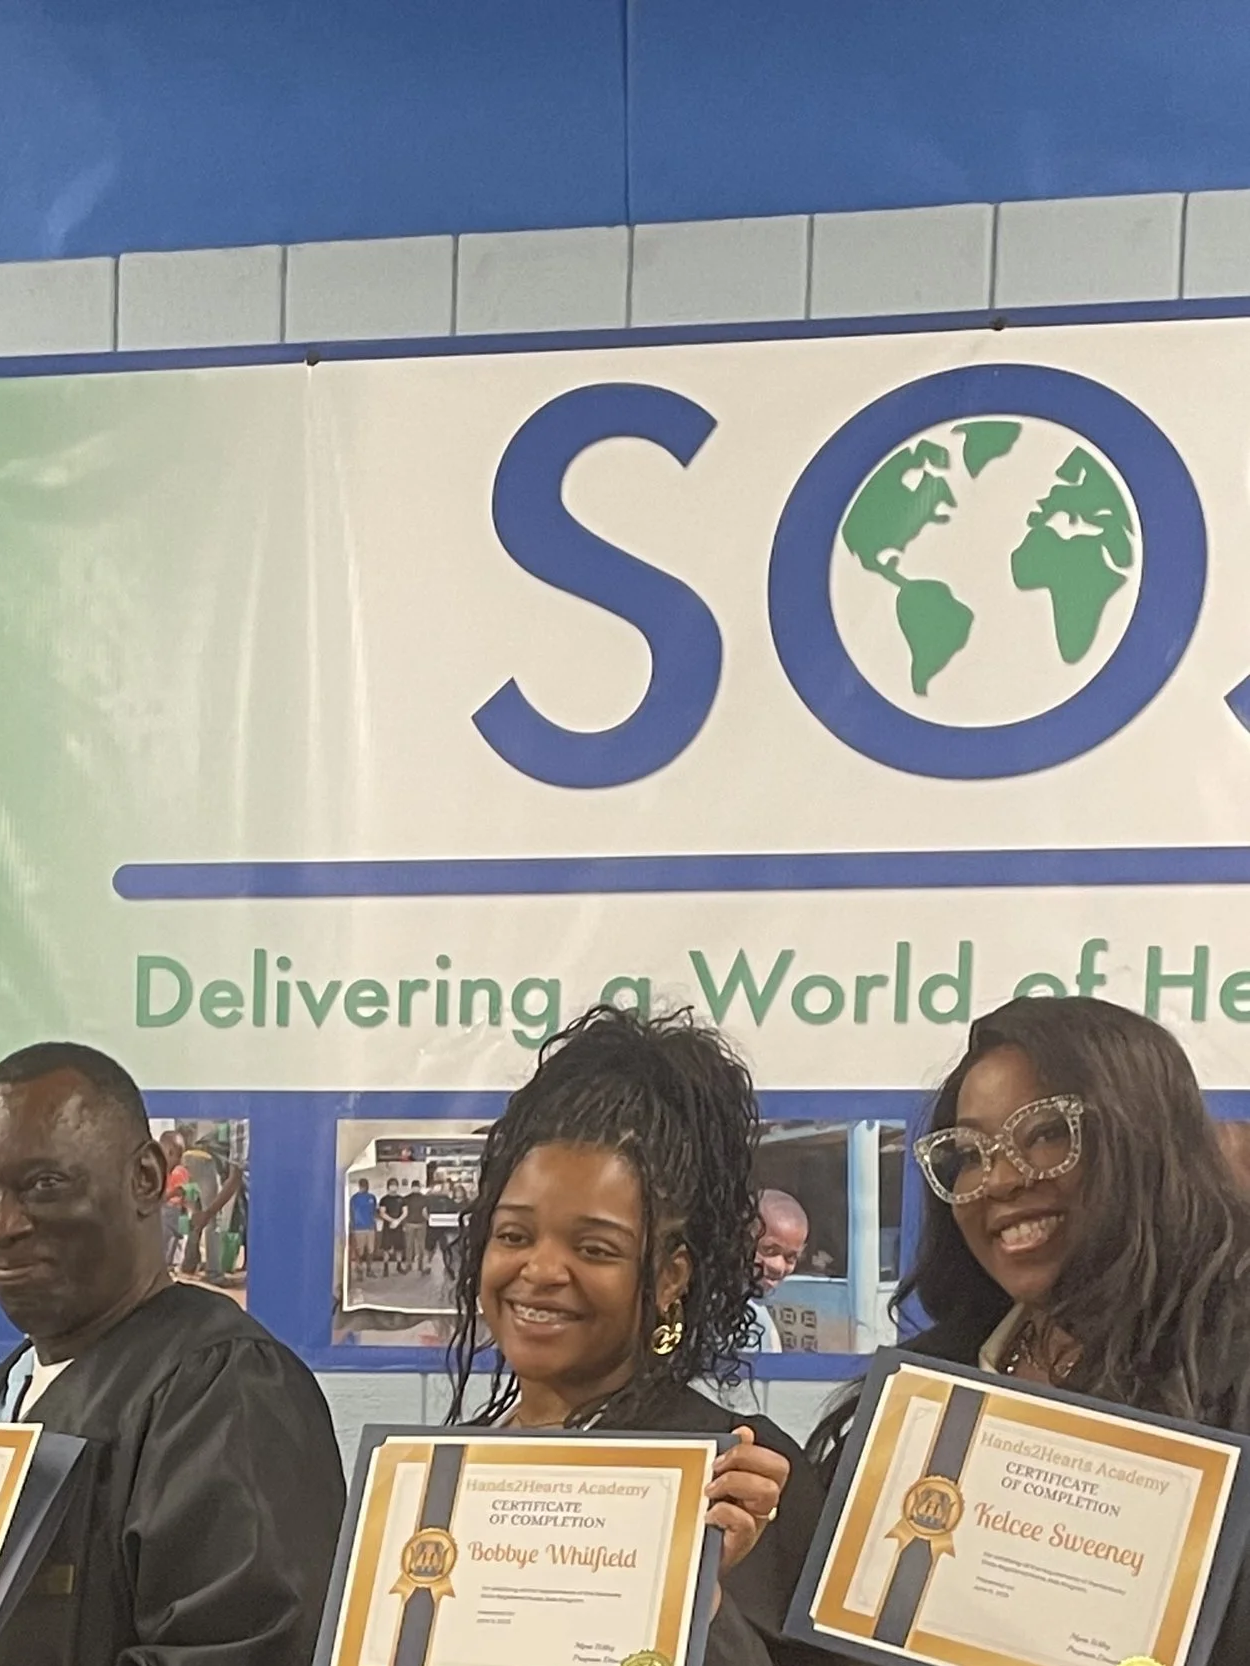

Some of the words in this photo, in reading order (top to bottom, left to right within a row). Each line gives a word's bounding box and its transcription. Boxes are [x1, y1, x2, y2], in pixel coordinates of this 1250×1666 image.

[472, 362, 1250, 789] SO
[136, 948, 561, 1050] Delivering
[600, 976, 651, 1026] a
[688, 940, 973, 1027] World
[980, 1431, 1094, 1473] Hands2Hearts
[1095, 1462, 1170, 1496] Academy
[1005, 1460, 1099, 1496] CERTIFICATE
[466, 1479, 572, 1495] Hands2Hearts
[577, 1481, 651, 1499] Academy
[491, 1499, 583, 1514] CERTIFICATE
[1001, 1476, 1020, 1490] OF
[1023, 1482, 1121, 1518] COMPLETION
[489, 1514, 508, 1525] OF
[510, 1514, 607, 1529] COMPLETION
[974, 1501, 1043, 1543] Kelcee
[1048, 1522, 1144, 1577] Sweeney
[467, 1540, 539, 1570] Bobbye
